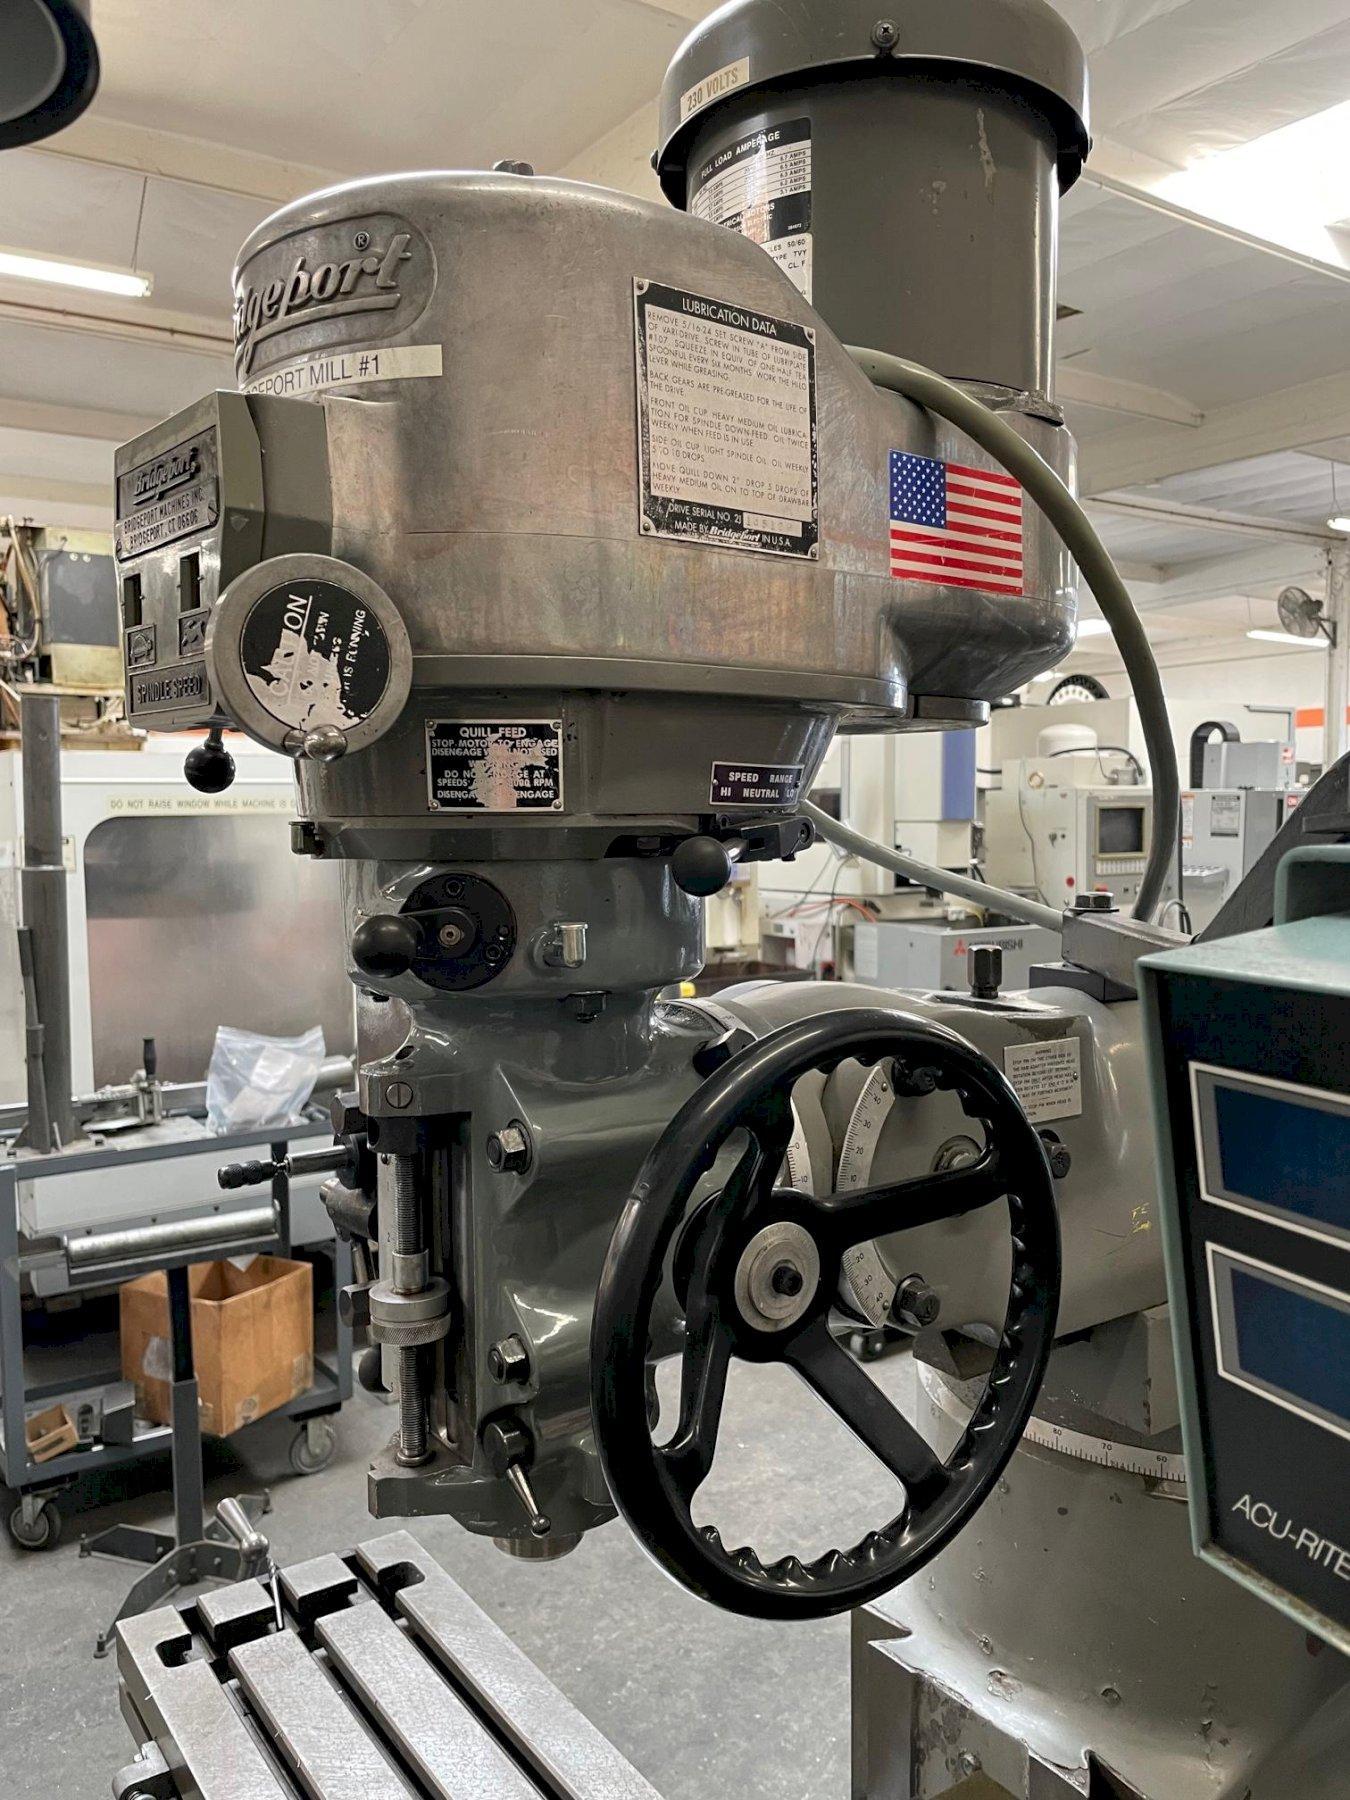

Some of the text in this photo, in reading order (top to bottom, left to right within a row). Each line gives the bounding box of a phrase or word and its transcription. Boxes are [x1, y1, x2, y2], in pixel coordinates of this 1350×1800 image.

[687, 67, 739, 112] 230 VOLTS
[701, 130, 781, 180] FULL LOAD AMPERAGE
[789, 150, 806, 159] AMPS
[789, 158, 806, 167] AMPS
[789, 168, 806, 176] AMPS
[789, 176, 806, 184] AMPS
[789, 184, 806, 192] AMPS
[793, 249, 807, 258] TVY
[682, 297, 777, 336] LUBRICATION DATA
[647, 311, 679, 326] REMOVE
[715, 329, 727, 339] SET
[730, 333, 753, 346] SCREW
[771, 345, 789, 356] FROM
[793, 351, 806, 361] SIDE
[648, 322, 658, 332] OF
[705, 337, 728, 350] SCREW
[733, 344, 739, 353] IN
[762, 352, 771, 361] OF
[674, 339, 707, 355] SQUEEZE
[748, 358, 757, 368] OF
[671, 359, 692, 372] WHILE
[688, 353, 709, 366] EVERY
[757, 371, 777, 383] WORK
[246, 354, 380, 396] EPORT MILL #1
[649, 381, 662, 391] THE
[649, 370, 668, 382] BACK
[672, 376, 694, 388] GEARS
[697, 382, 710, 391] ARE
[757, 396, 769, 405] FOR
[772, 400, 783, 408] THE
[799, 406, 807, 414] OF
[650, 397, 778, 432] FRONT OIL HEAVY MEDIUM OIL
[651, 408, 808, 448] TION FOR SPINDLE OIL TWICE
[651, 419, 679, 431] WEEKLY
[681, 425, 703, 436] WHEN
[706, 430, 722, 440] FEED
[732, 435, 739, 443] IN
[652, 434, 808, 473] SIDE OIL LIGHT SPINDLE OIL WEEKLY
[659, 446, 669, 455] TO
[652, 461, 676, 473] MOVE
[679, 466, 700, 477] QUILL
[704, 470, 728, 482] DOWN
[775, 484, 797, 494] DROPS
[801, 488, 809, 497] OF
[653, 482, 680, 494] WEEKLY
[653, 472, 809, 506] HEAVY MEDIUM OIL ON TO TOP OF DRAWBAR
[124, 506, 158, 535] BRIDGEPORT
[160, 493, 190, 519] MACHINES
[668, 502, 715, 520] DRIVE SERIAL
[674, 520, 697, 532] MADE
[709, 525, 761, 544] Bridgeport
[345, 609, 367, 663] RUNNING
[269, 594, 308, 697] CAUON
[343, 665, 354, 678] IS
[137, 674, 202, 704] SPINDLE SPEED
[459, 726, 527, 738] QUILL FEED
[431, 739, 455, 748] STOP
[497, 739, 512, 748] TO
[516, 738, 559, 748] ENGAGE
[431, 748, 482, 757] DISENGAGE
[444, 770, 459, 778] DO
[462, 770, 477, 778] NO
[533, 769, 546, 779] AT
[728, 771, 794, 784] SPEED RANGE
[437, 778, 469, 787] SPEEDS
[533, 778, 554, 787] RPM
[437, 790, 555, 799] DISENGA ENGAGE
[720, 786, 795, 799] HI NEUTRAL LO
[110, 800, 123, 809] DO
[127, 800, 144, 809] NOT
[148, 799, 172, 808] RAISE
[176, 799, 211, 808] WINDOW
[213, 799, 238, 808] WHILE
[241, 799, 277, 808] MACHINE
[278, 799, 287, 808] IS
[873, 1093, 881, 1105] 40
[862, 1119, 871, 1129] 30
[855, 1146, 864, 1155] 20
[800, 1174, 808, 1183] 10
[850, 1174, 857, 1183] 10
[855, 1252, 865, 1264] 20
[864, 1274, 873, 1286] 30
[875, 1291, 884, 1303] 40
[1052, 1427, 1063, 1436] 80
[1101, 1442, 1113, 1451] 70
[1156, 1455, 1168, 1463] 60
[1231, 1493, 1350, 1581] ACU-RITE
